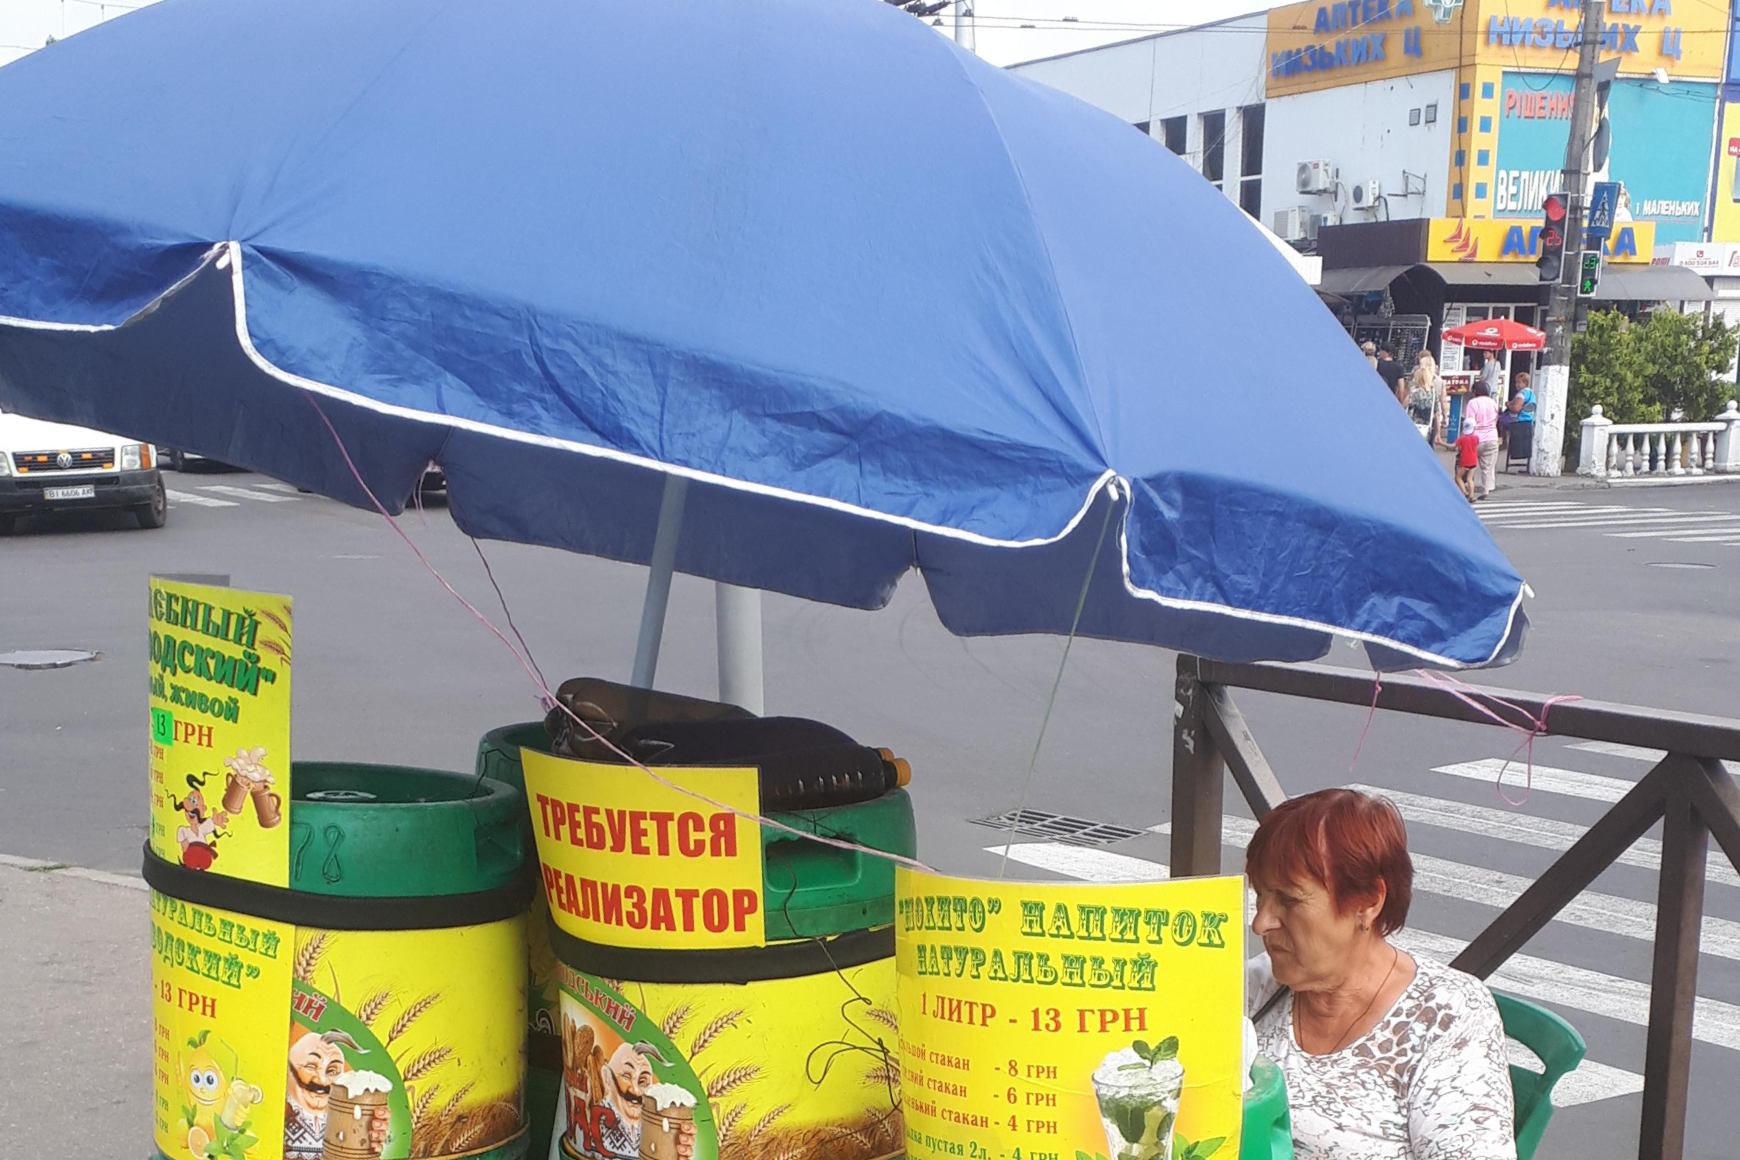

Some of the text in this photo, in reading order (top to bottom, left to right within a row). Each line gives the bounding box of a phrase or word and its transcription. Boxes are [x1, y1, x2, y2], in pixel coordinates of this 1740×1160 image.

[1314, 0, 1414, 35] АПТЕКА
[1271, 26, 1423, 79] НИЗЬКИХ Ц
[1662, 26, 1682, 61] Ц
[1496, 169, 1565, 212] ВЕЛИКИ
[1643, 200, 1701, 218] МАЛЕНЬКИХ
[173, 719, 214, 749] ГРН
[536, 793, 739, 859] ТРЕБУЕТСЯ
[542, 861, 759, 933] РЕАЛИЗАТОР
[1020, 900, 1229, 949] НАПИТОК
[917, 944, 1159, 992] НАТУРАЛЬНЫЙ
[161, 979, 172, 1003] 13
[178, 987, 218, 1019] ГРН
[921, 992, 928, 1016] 1
[932, 994, 997, 1027] ЛИТР
[1030, 1007, 1062, 1033] 13
[1077, 1007, 1149, 1034] ГРН
[929, 1051, 971, 1072] стакан
[1008, 1059, 1019, 1077] 8
[1026, 1064, 1058, 1080] ГРН
[927, 1077, 968, 1098] стакан
[1006, 1086, 1018, 1105] 6
[1025, 1092, 1058, 1108] ГРН
[941, 1107, 990, 1129] стакан
[1007, 1115, 1019, 1132] 4
[1026, 1119, 1059, 1135] ГРН
[925, 1134, 965, 1157] пустая
